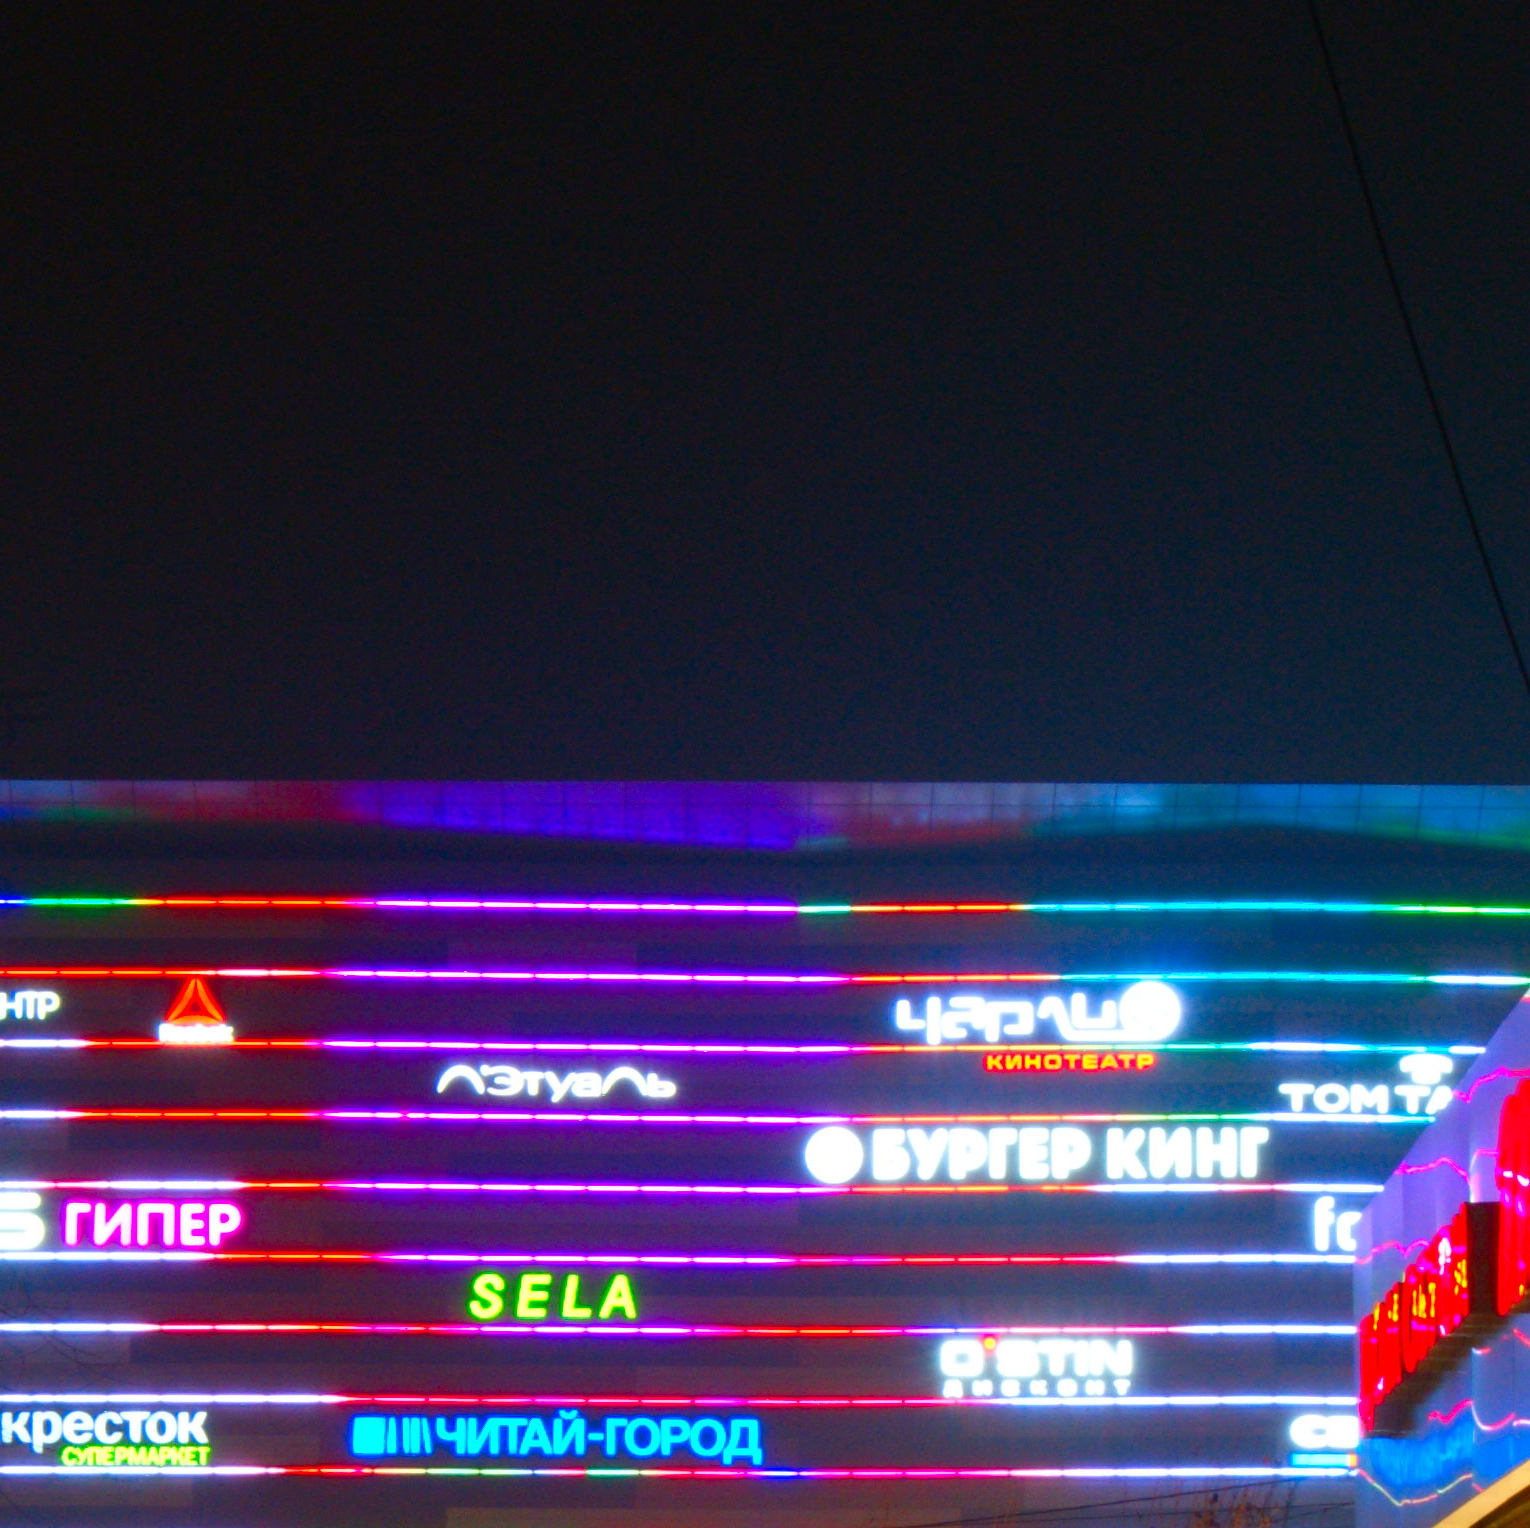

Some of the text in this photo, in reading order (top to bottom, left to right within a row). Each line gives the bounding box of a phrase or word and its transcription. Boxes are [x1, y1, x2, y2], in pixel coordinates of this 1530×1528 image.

[984, 1052, 1156, 1071] КИНОТЕАТР
[1278, 1083, 1389, 1114] TOM
[871, 1126, 1270, 1181] БУРГЕР КИНГ
[64, 1201, 243, 1247] ГИПЕР
[469, 1273, 637, 1319] SELA
[60, 1446, 210, 1466] СУПЕРМАРКЕТ
[436, 1409, 762, 1465] ЧИТАЙ-ГОРОД
